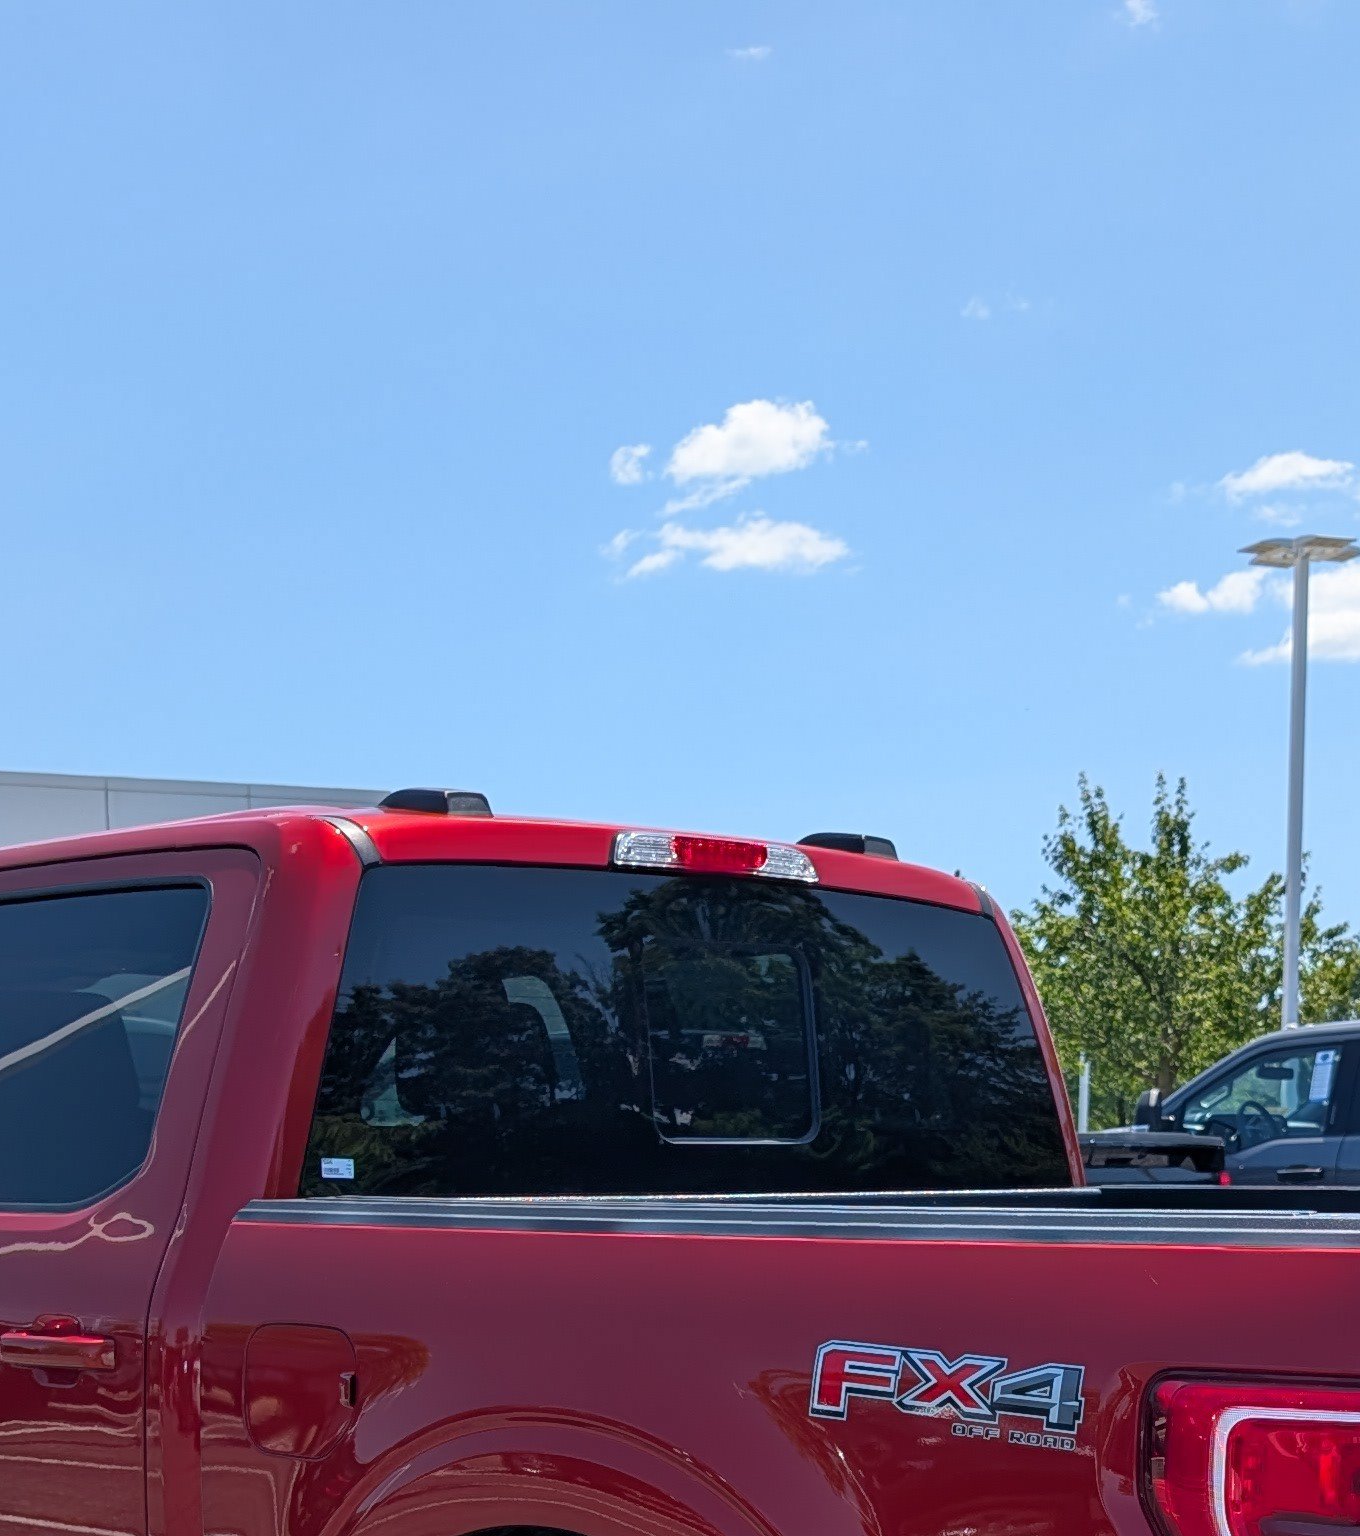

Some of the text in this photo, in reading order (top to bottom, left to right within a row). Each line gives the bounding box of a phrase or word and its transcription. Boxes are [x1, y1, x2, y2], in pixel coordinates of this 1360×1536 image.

[809, 1340, 1085, 1434] FX4
[951, 1423, 1076, 1451] OFF ROAD
